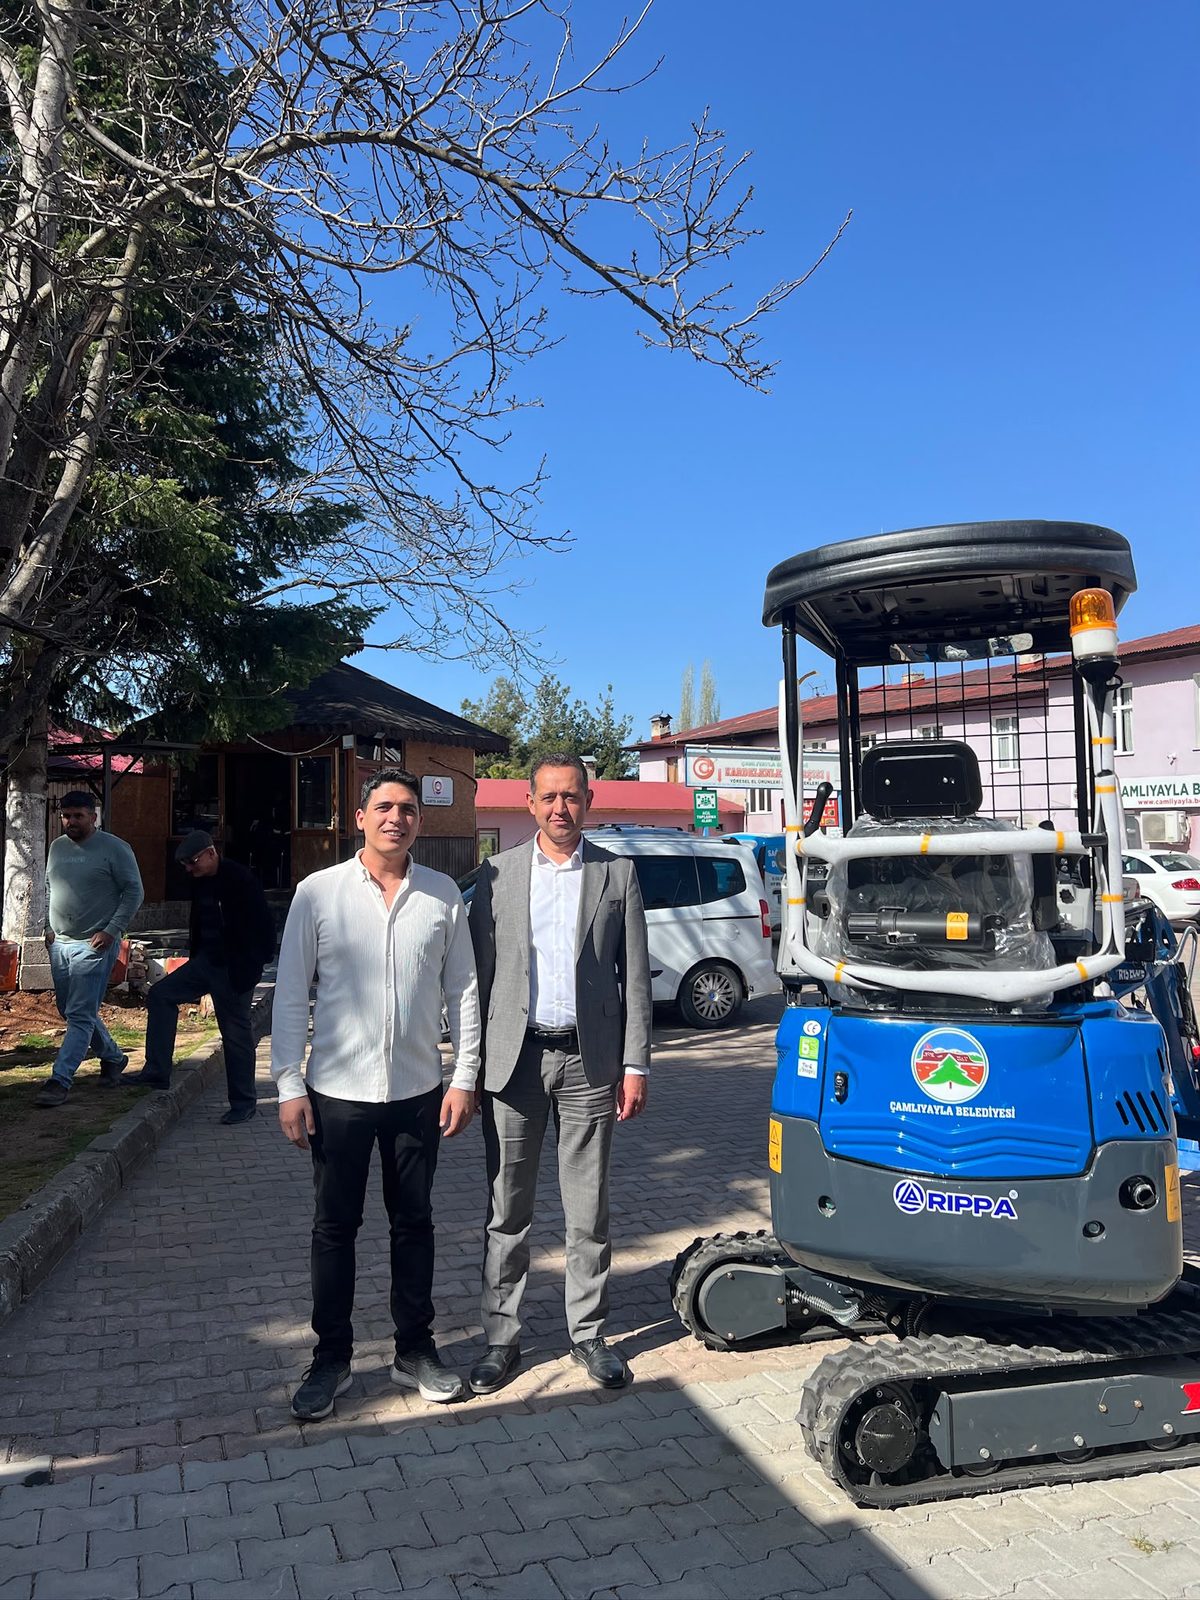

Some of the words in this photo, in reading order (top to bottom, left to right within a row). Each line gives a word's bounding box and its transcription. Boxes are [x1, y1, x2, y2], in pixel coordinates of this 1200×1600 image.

[1121, 783, 1189, 798] AMLIYAYLA
[889, 1101, 954, 1116] ÇAMLIYAYLA
[955, 1105, 1016, 1119] BELEDİYESİ
[926, 1190, 1018, 1219] RIPPA
